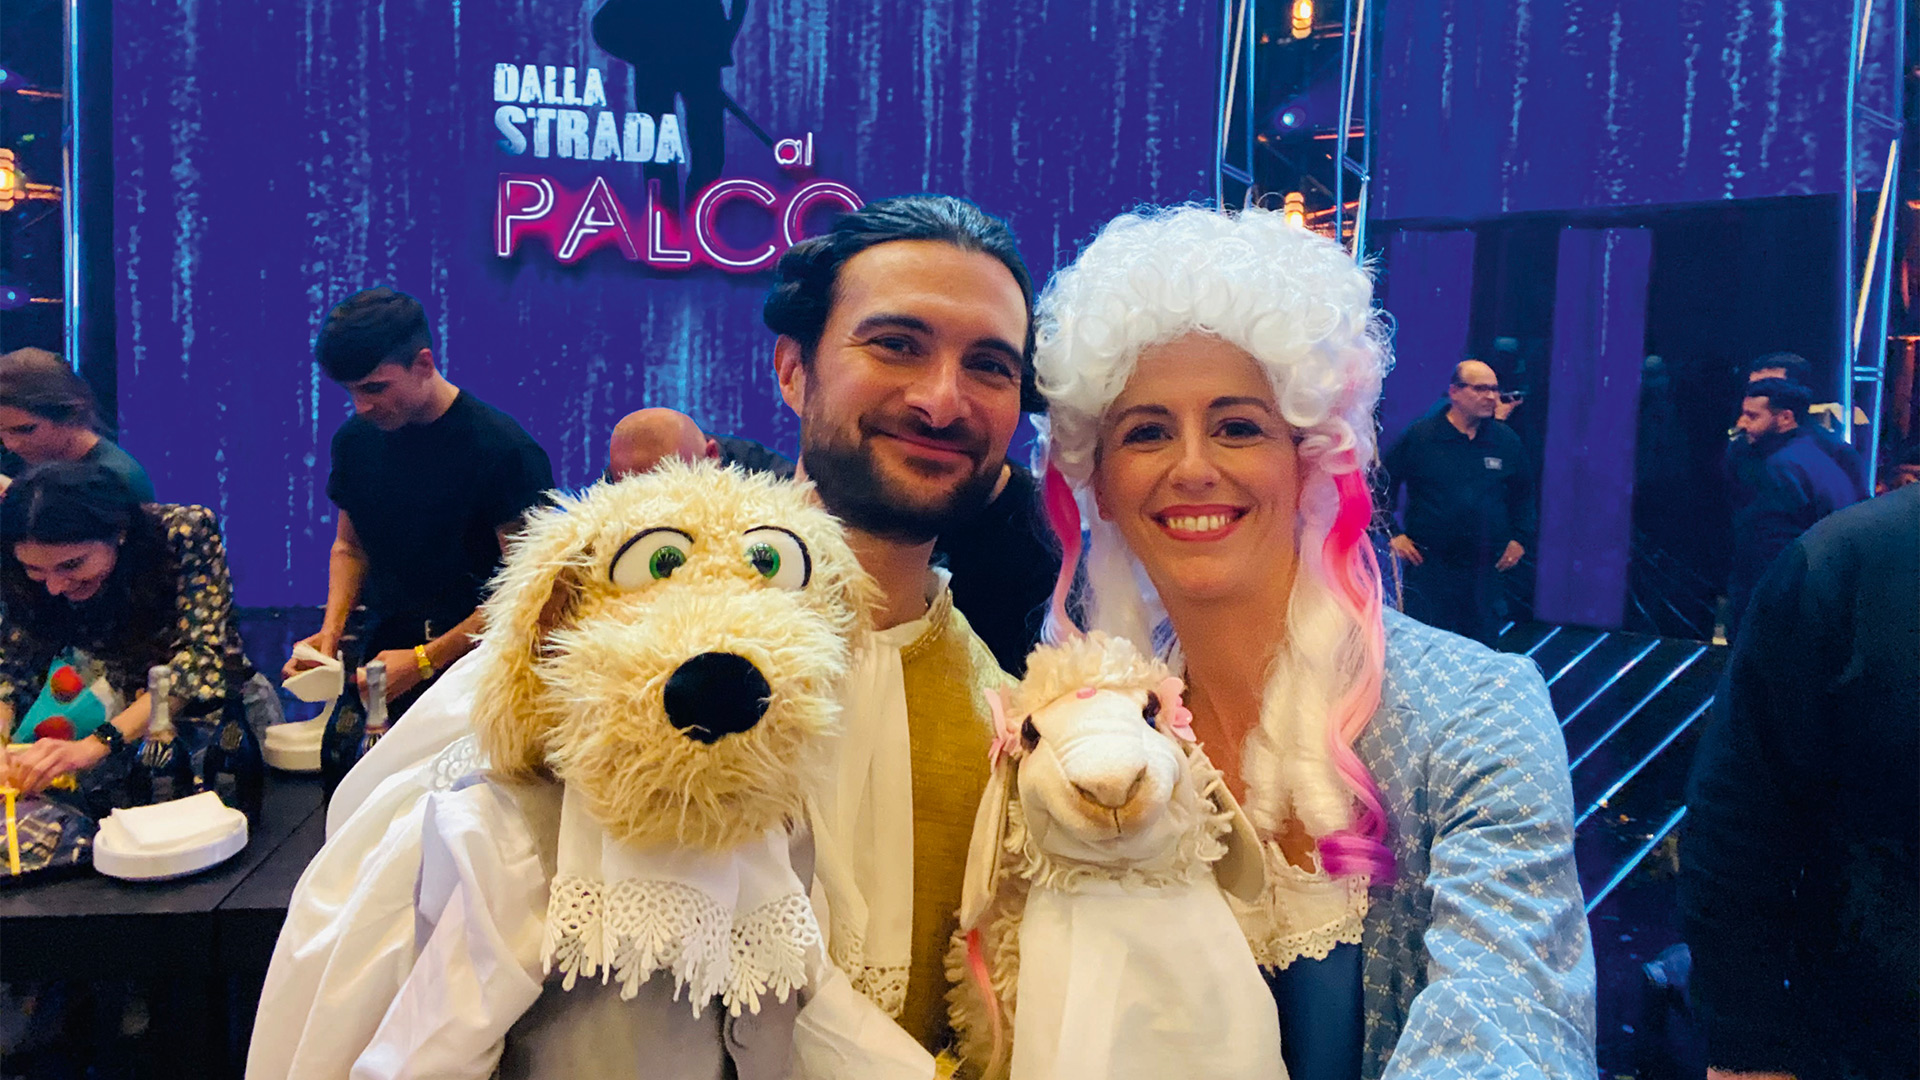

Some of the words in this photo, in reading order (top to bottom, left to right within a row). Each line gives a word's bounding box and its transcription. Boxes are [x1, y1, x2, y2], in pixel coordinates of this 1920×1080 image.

[494, 63, 607, 107] DALLA
[494, 105, 686, 163] STRADA
[774, 132, 813, 166] al
